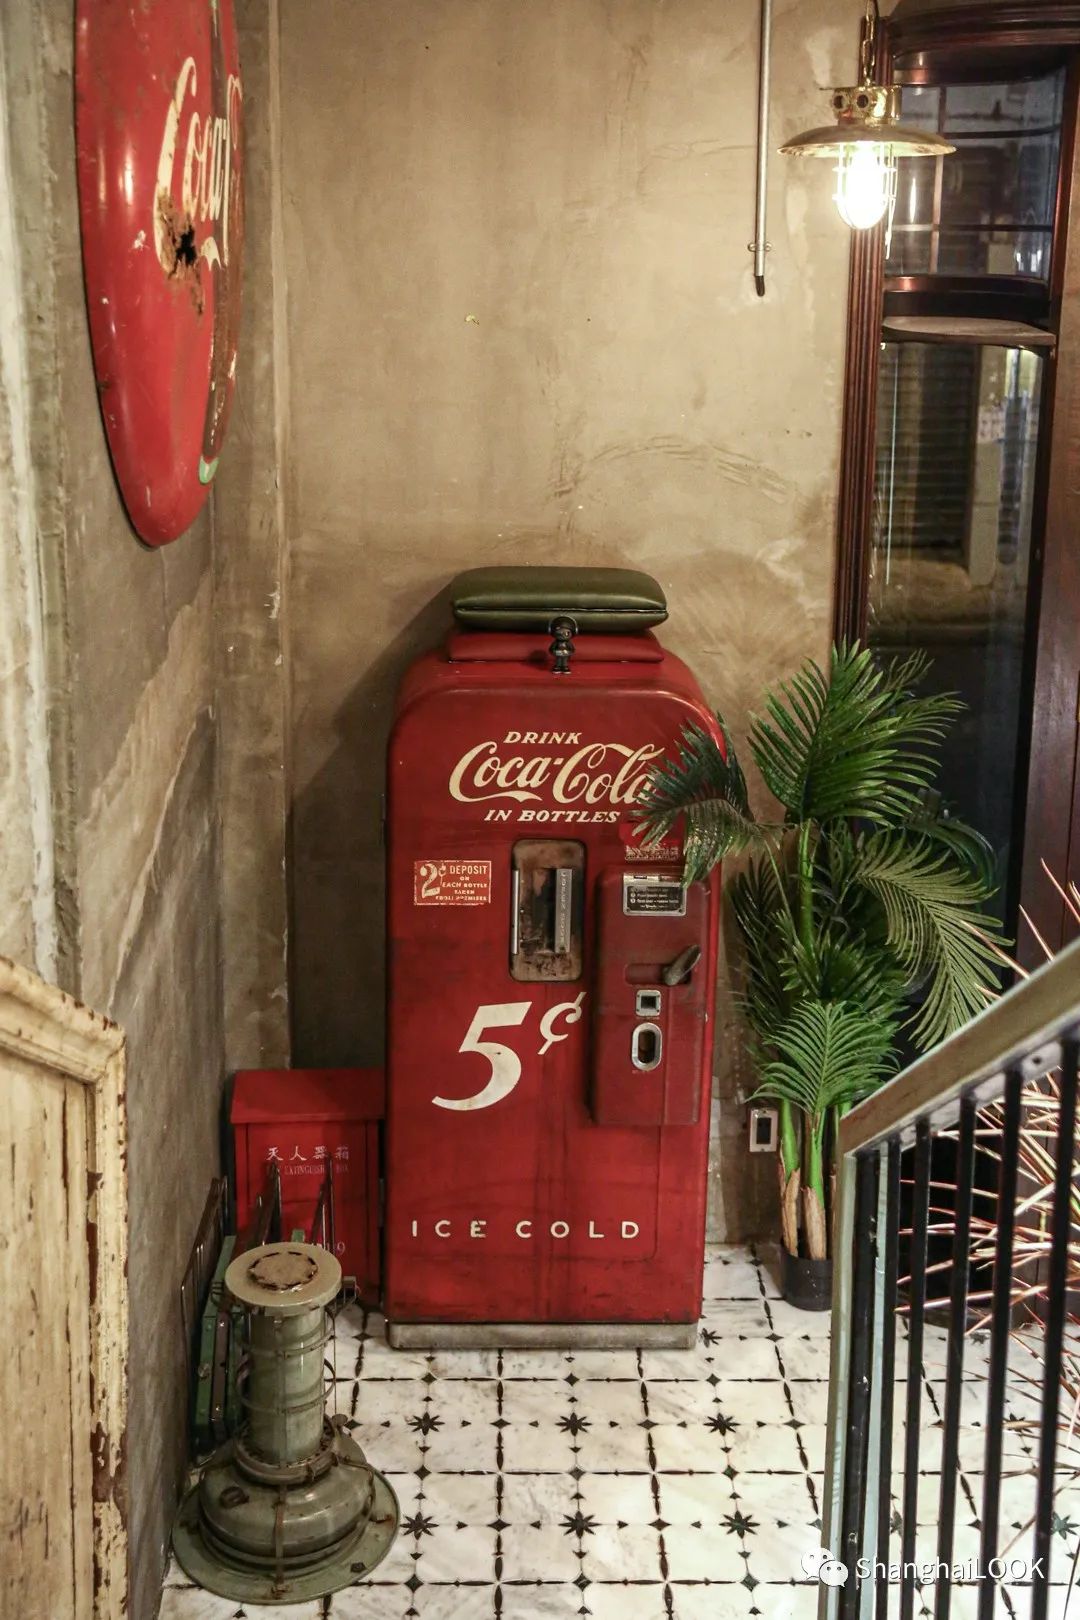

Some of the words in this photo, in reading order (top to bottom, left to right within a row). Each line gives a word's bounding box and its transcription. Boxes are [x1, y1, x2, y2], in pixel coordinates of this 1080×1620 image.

[503, 731, 583, 745] DRINK
[484, 809, 513, 823] IN
[515, 810, 621, 824] BOTTLES
[449, 865, 488, 875] DEPOSIT
[411, 1219, 487, 1238] ICE
[515, 1219, 640, 1239] COLD
